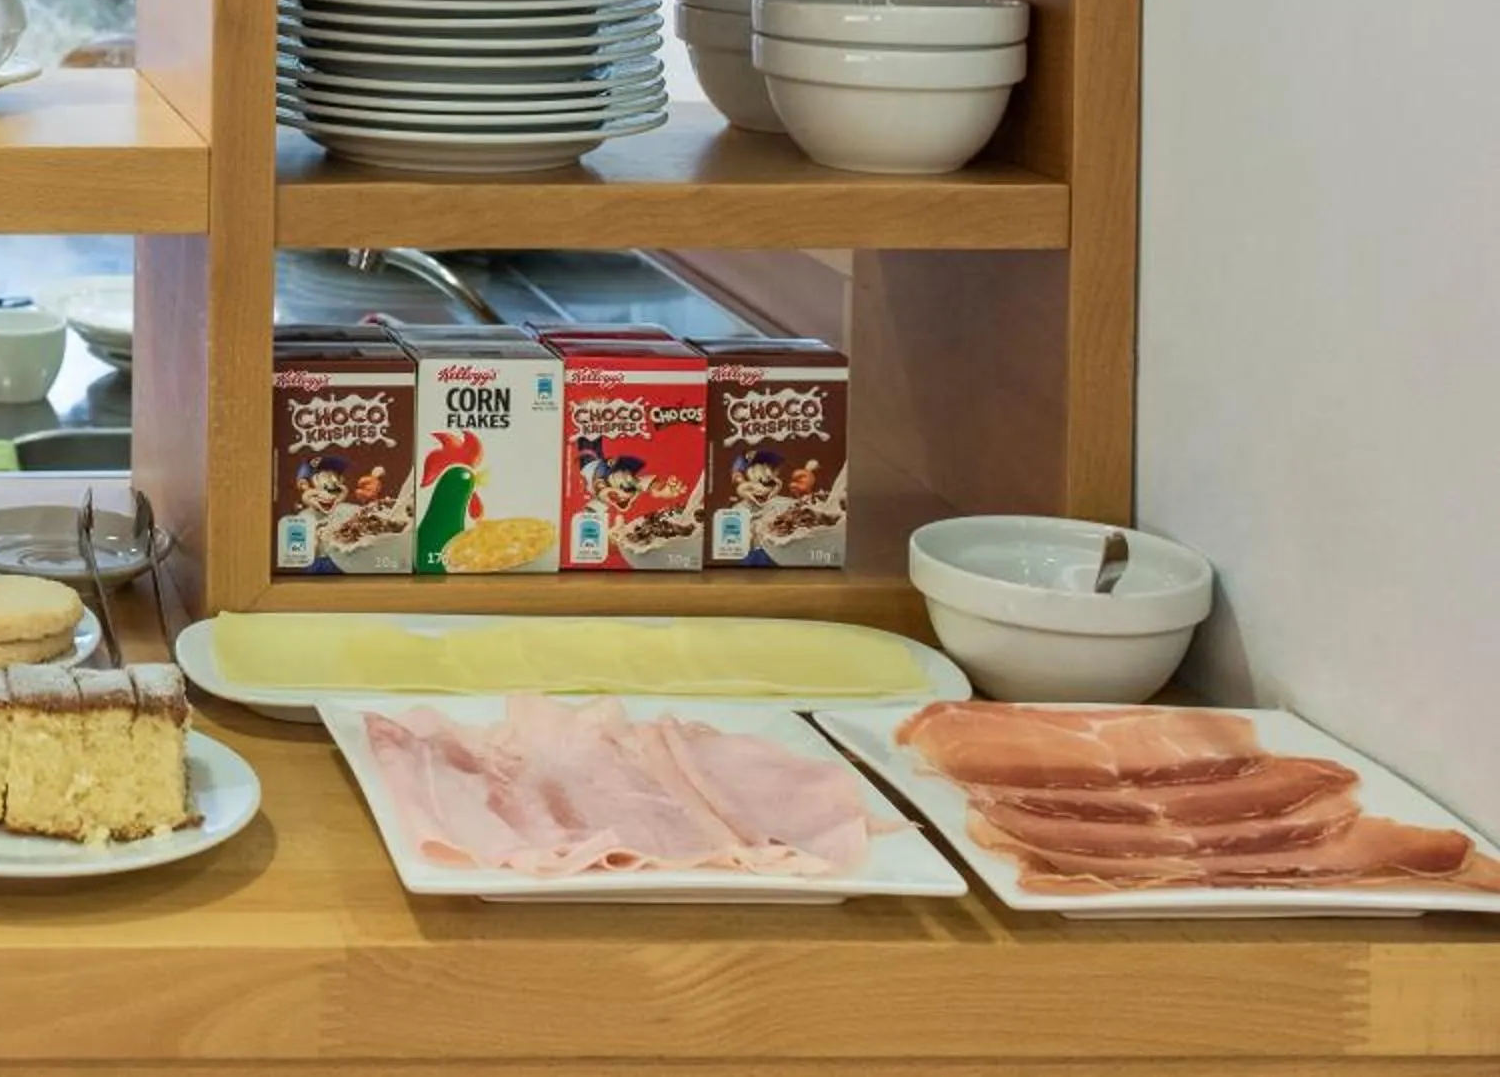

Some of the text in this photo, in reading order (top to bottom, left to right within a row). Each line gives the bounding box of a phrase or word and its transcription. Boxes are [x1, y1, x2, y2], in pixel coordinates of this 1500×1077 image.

[438, 364, 498, 386] Kellogg's
[446, 387, 511, 413] CORN
[294, 405, 387, 430] CHOCO
[574, 405, 644, 423] CHOCO
[651, 407, 705, 423] CHOCOS
[730, 398, 820, 423] CHOCO
[447, 413, 511, 429] FLAKES
[583, 422, 638, 436] KRISPIES
[741, 418, 811, 437] KRISPIES
[306, 424, 378, 444] KRISPIES
